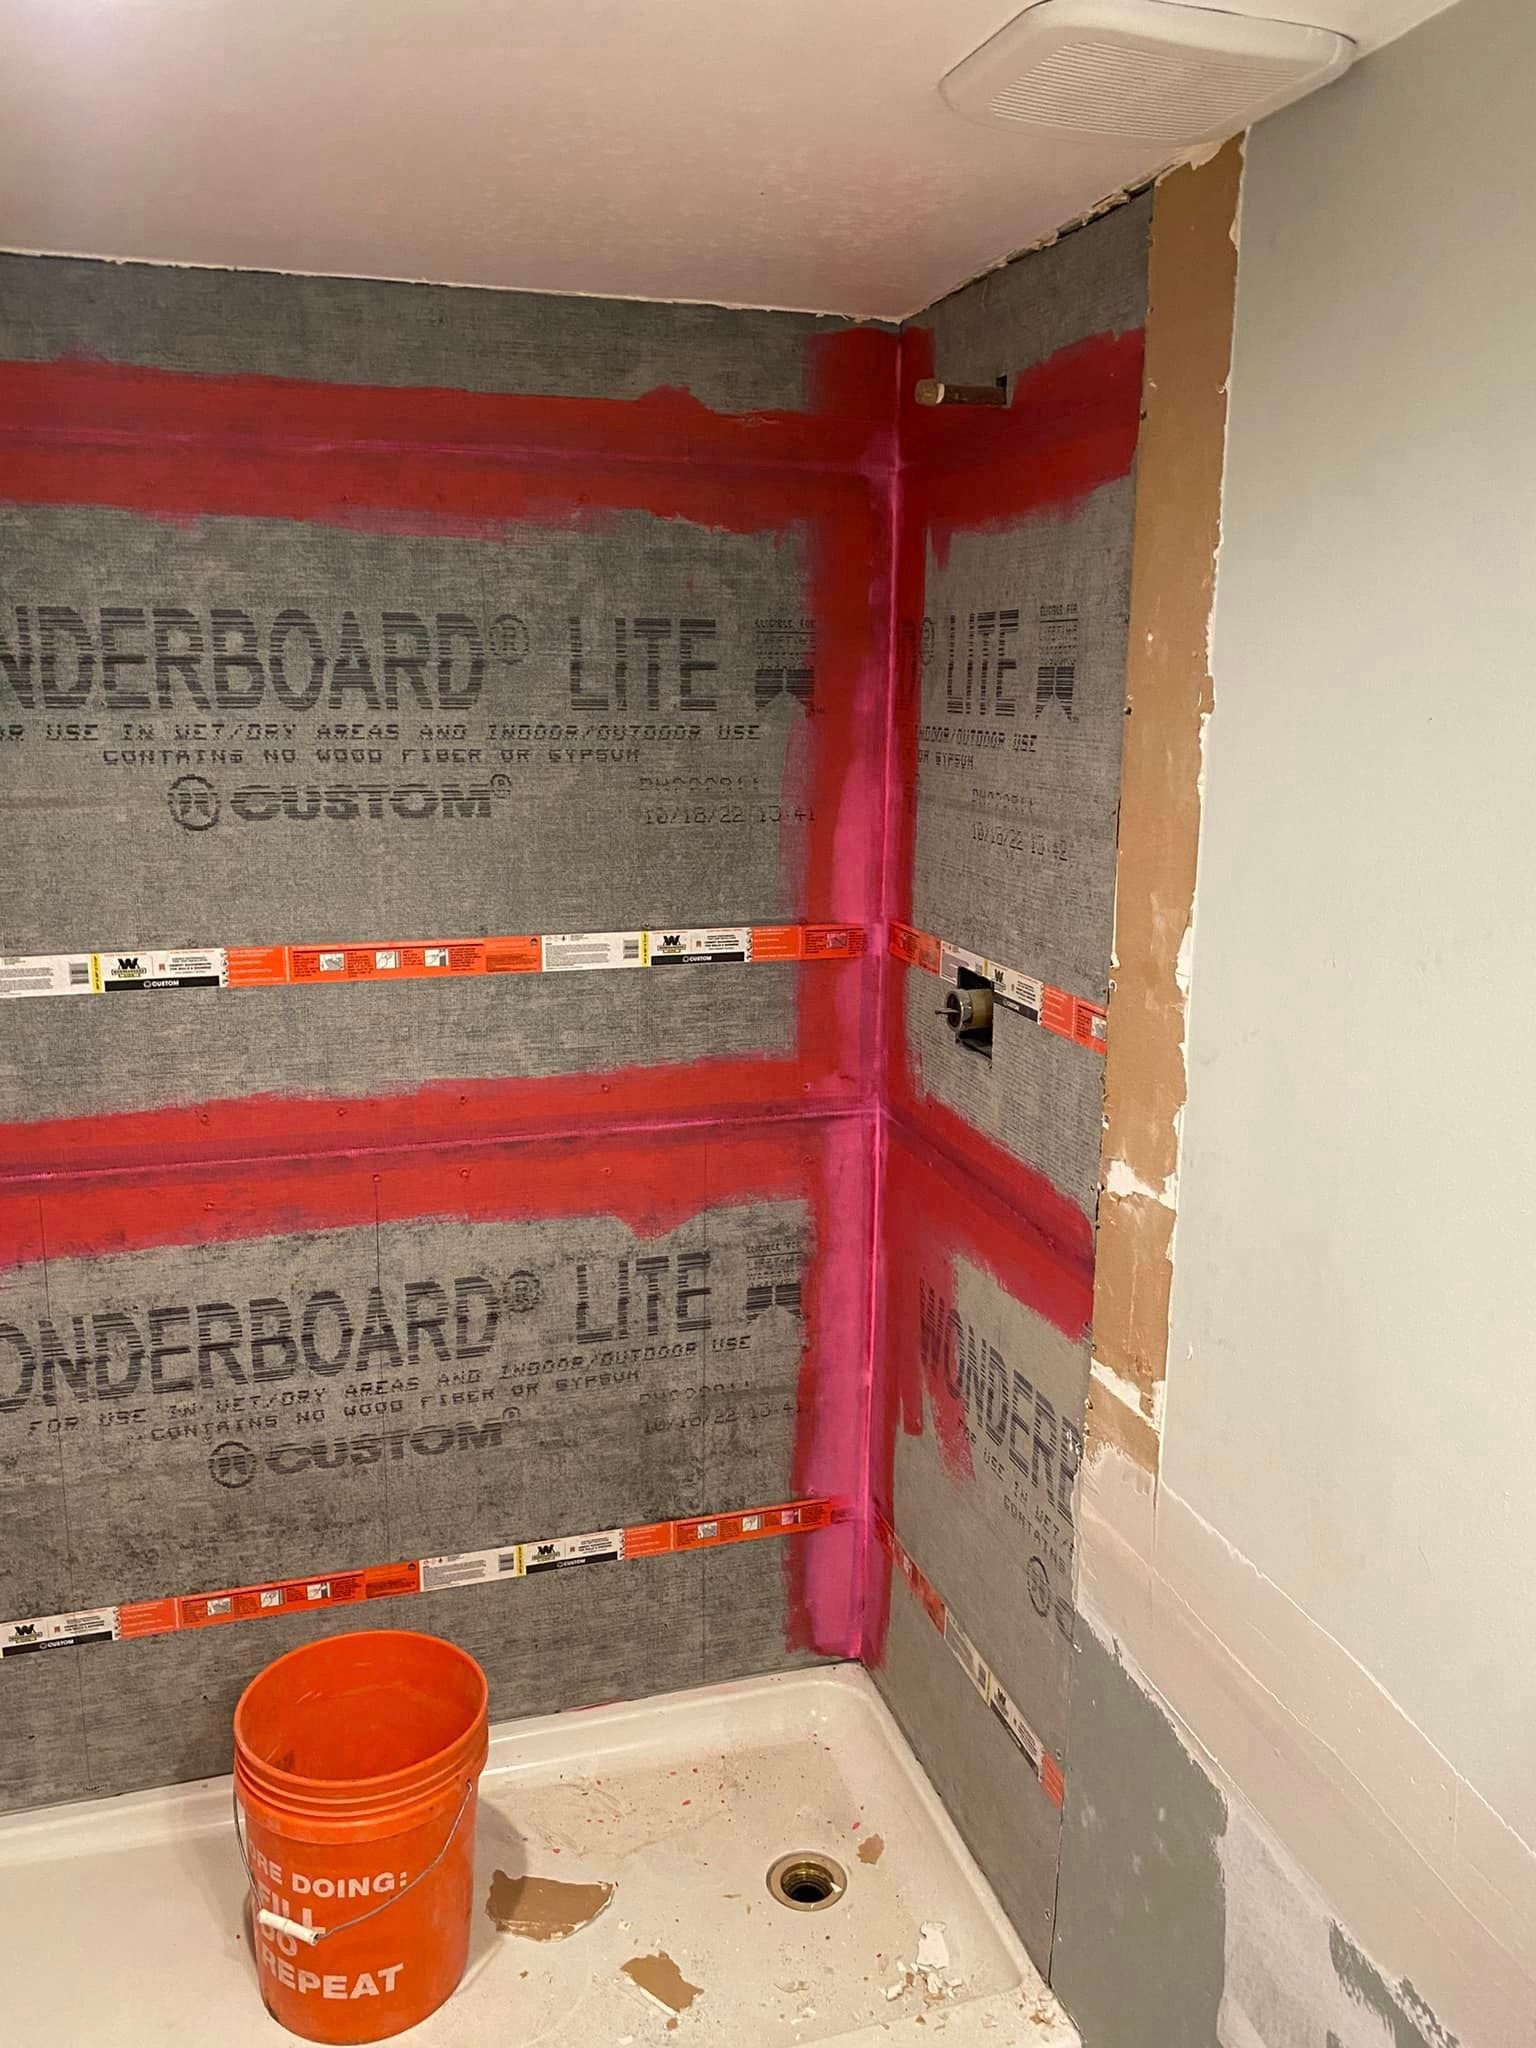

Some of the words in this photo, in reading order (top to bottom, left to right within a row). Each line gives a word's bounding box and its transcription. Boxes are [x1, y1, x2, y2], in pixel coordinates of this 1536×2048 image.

[569, 616, 717, 711] LITE
[947, 609, 1019, 716] LITE
[46, 724, 98, 741] USE
[121, 724, 153, 741] IN
[174, 723, 297, 741] WET/DRY
[316, 724, 400, 741] AREAS
[419, 725, 466, 741] AND
[486, 725, 701, 742] INDOOR/OUTDOOR
[718, 725, 760, 741] USE
[103, 749, 243, 765] CONTAINS
[264, 749, 298, 764] NO
[317, 749, 383, 764] WOOD
[402, 749, 482, 764] FIBER
[501, 749, 531, 763] OR
[549, 749, 640, 763] GYPSUM
[1013, 733, 1038, 753] USE
[151, 979, 179, 987] CUSTOM
[577, 1251, 712, 1345] LITE
[29, 1416, 78, 1437] FOR
[100, 1408, 147, 1426] USE
[168, 1402, 200, 1420] IN
[216, 1387, 326, 1412] WET/DRY
[344, 1377, 419, 1398] AREAS
[438, 1369, 480, 1387] AND
[499, 1342, 697, 1380] INDOOR/OUTDOOR
[713, 1335, 752, 1352] USE
[151, 1415, 278, 1442] CONTAINS
[297, 1409, 326, 1425] NO
[344, 1399, 403, 1417] WOOD
[420, 1387, 495, 1409] FIBER
[511, 1382, 539, 1396] OR
[555, 1371, 640, 1394] GYPSUM
[292, 1871, 407, 1898] DOING:
[261, 1942, 404, 2001] REPEAT
